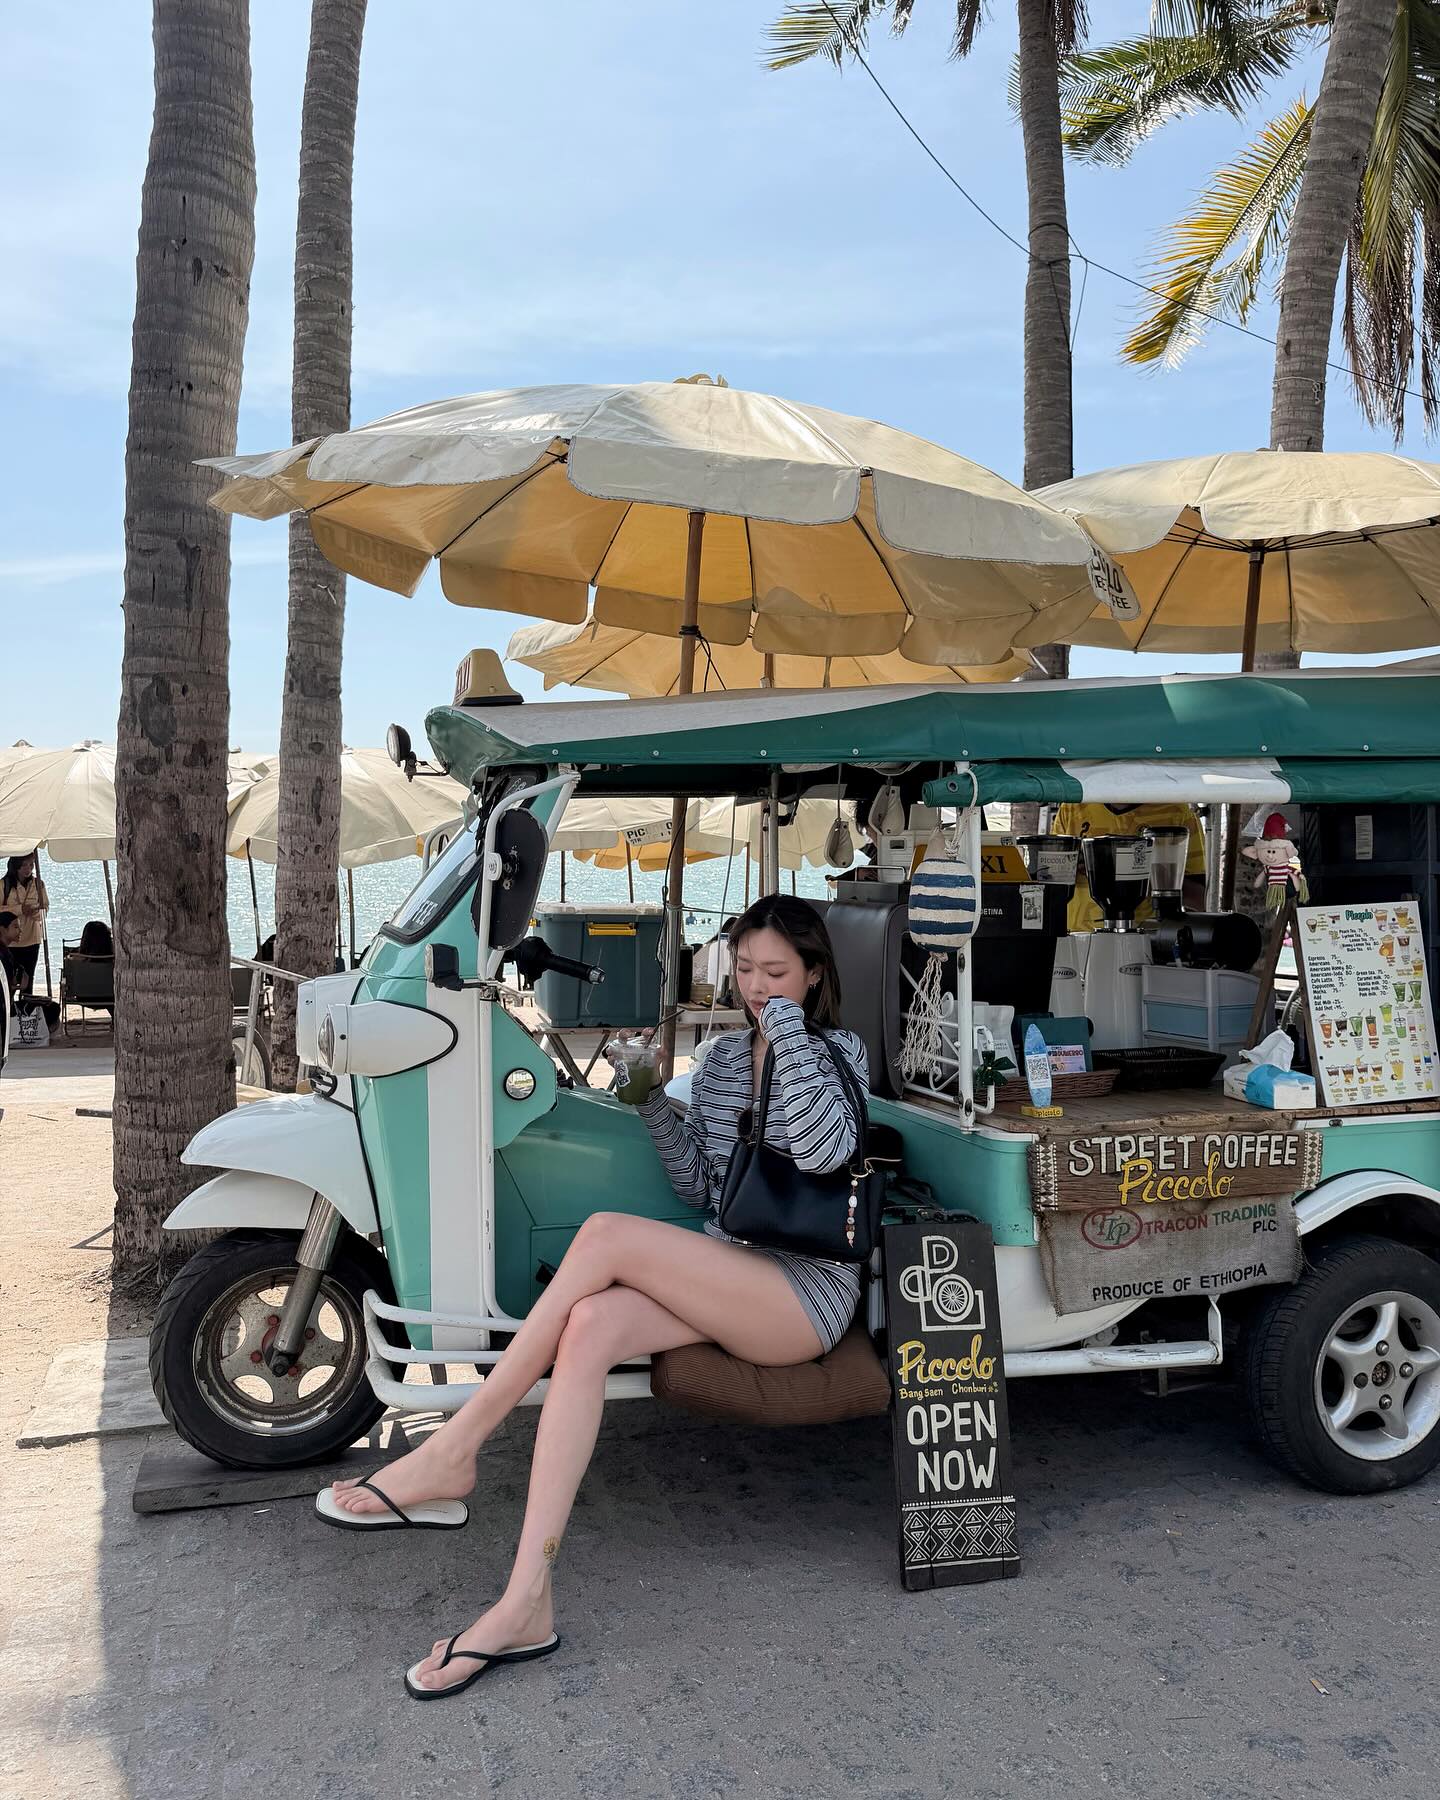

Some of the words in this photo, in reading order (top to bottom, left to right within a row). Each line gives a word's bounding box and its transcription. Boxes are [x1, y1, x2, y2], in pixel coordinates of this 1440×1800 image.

[981, 855, 1009, 874] XI
[1069, 1134, 1196, 1176] STREET
[1204, 1133, 1299, 1169] COFFEE
[1118, 1151, 1235, 1206] Piccolo
[1143, 1214, 1209, 1235] TRACON
[1212, 1202, 1276, 1226] TRADING
[1252, 1219, 1277, 1234] PLC
[1092, 1280, 1164, 1302] PRODUCE
[1172, 1277, 1192, 1293] OF
[1199, 1262, 1268, 1289] ETHIOPIA
[897, 1333, 998, 1385] Piccolo
[951, 1382, 987, 1395] Chonburi
[906, 1400, 998, 1446] OPEN
[917, 1446, 997, 1494] NOW
